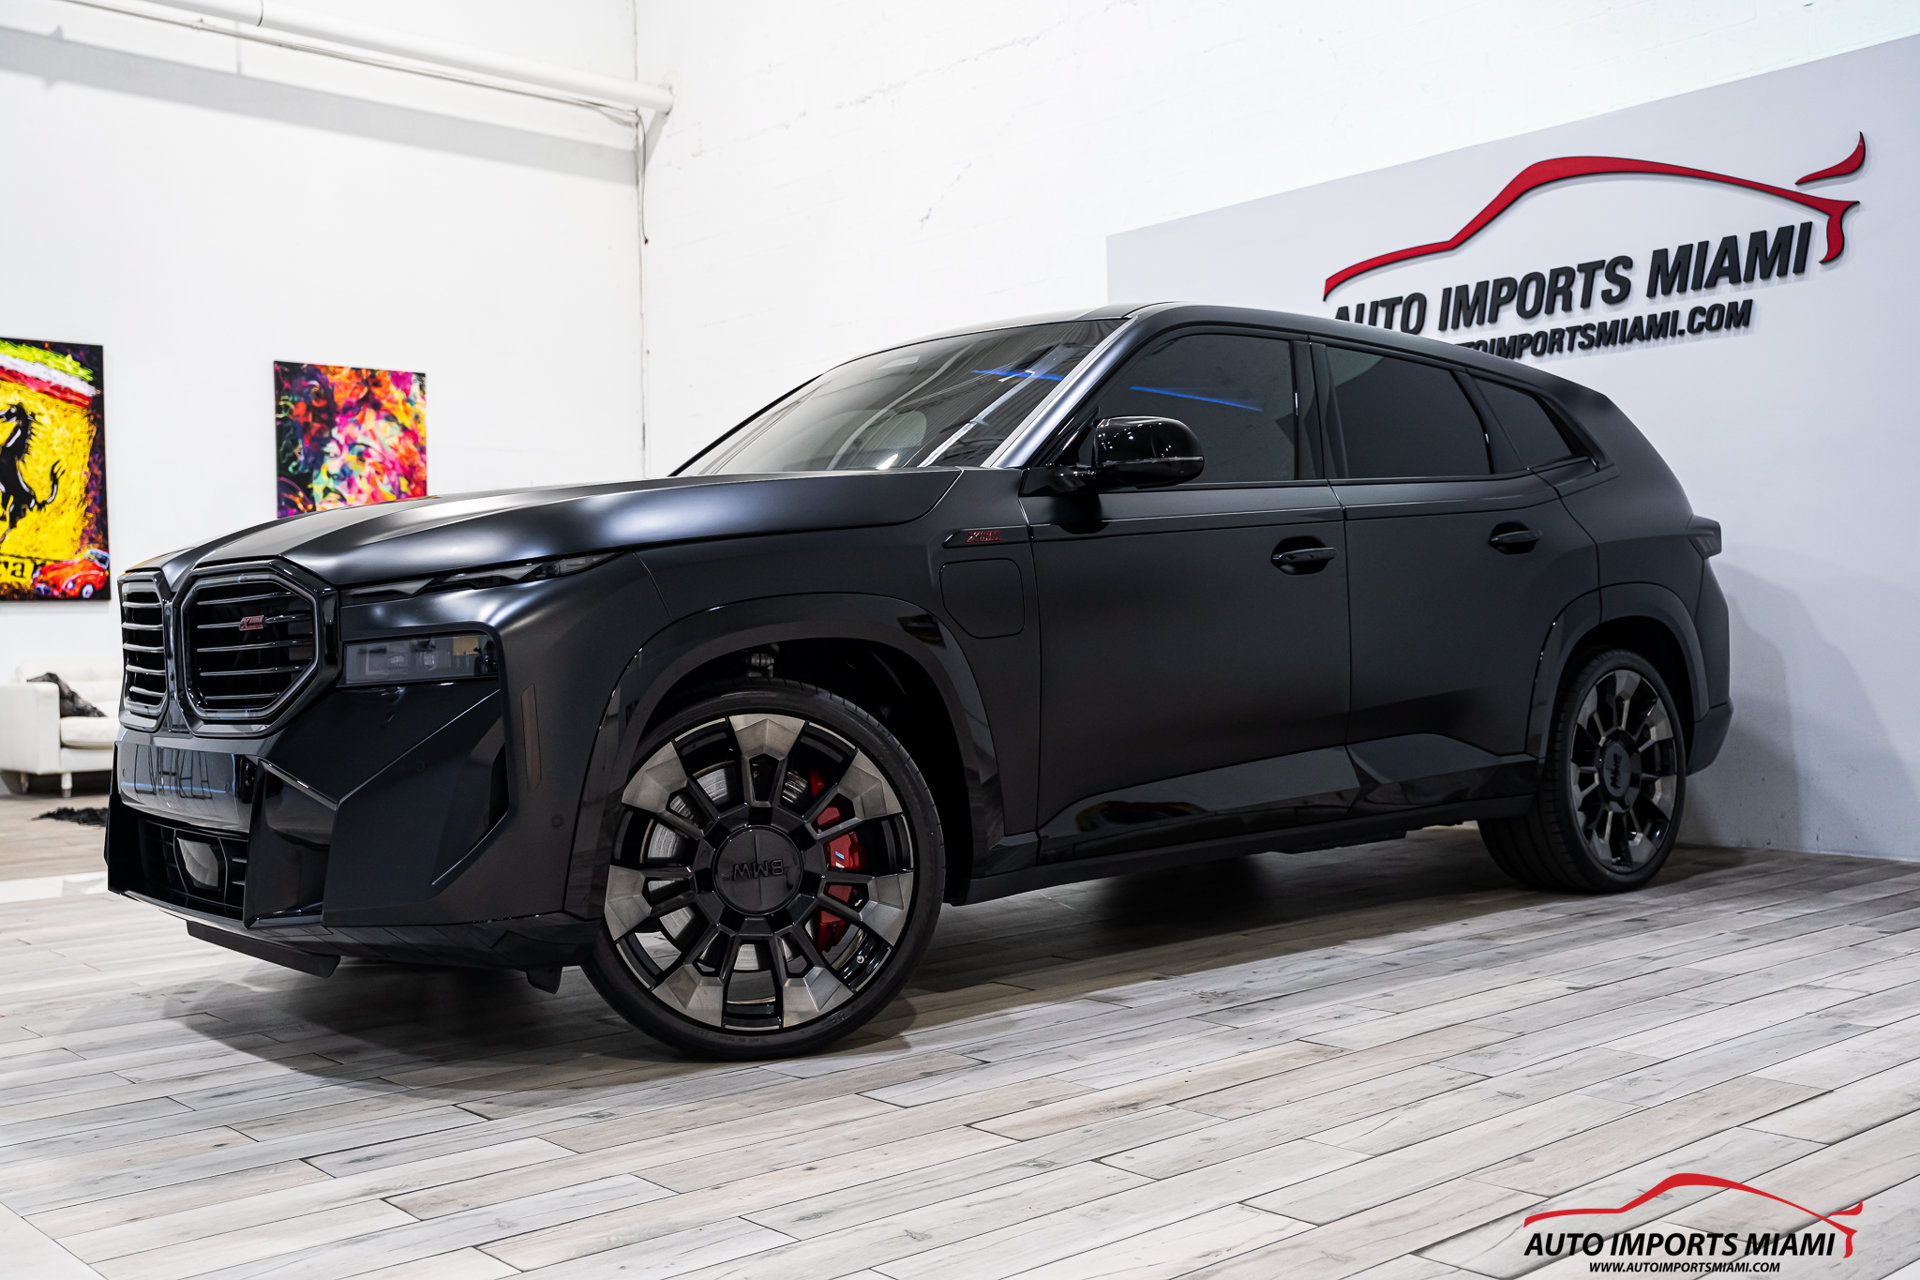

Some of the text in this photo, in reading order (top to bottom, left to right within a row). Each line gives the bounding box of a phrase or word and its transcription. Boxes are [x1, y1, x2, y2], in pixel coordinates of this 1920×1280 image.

[1438, 255, 1634, 332] IMPORTS
[1646, 221, 1813, 298] MIAMI
[733, 859, 784, 881] BMW
